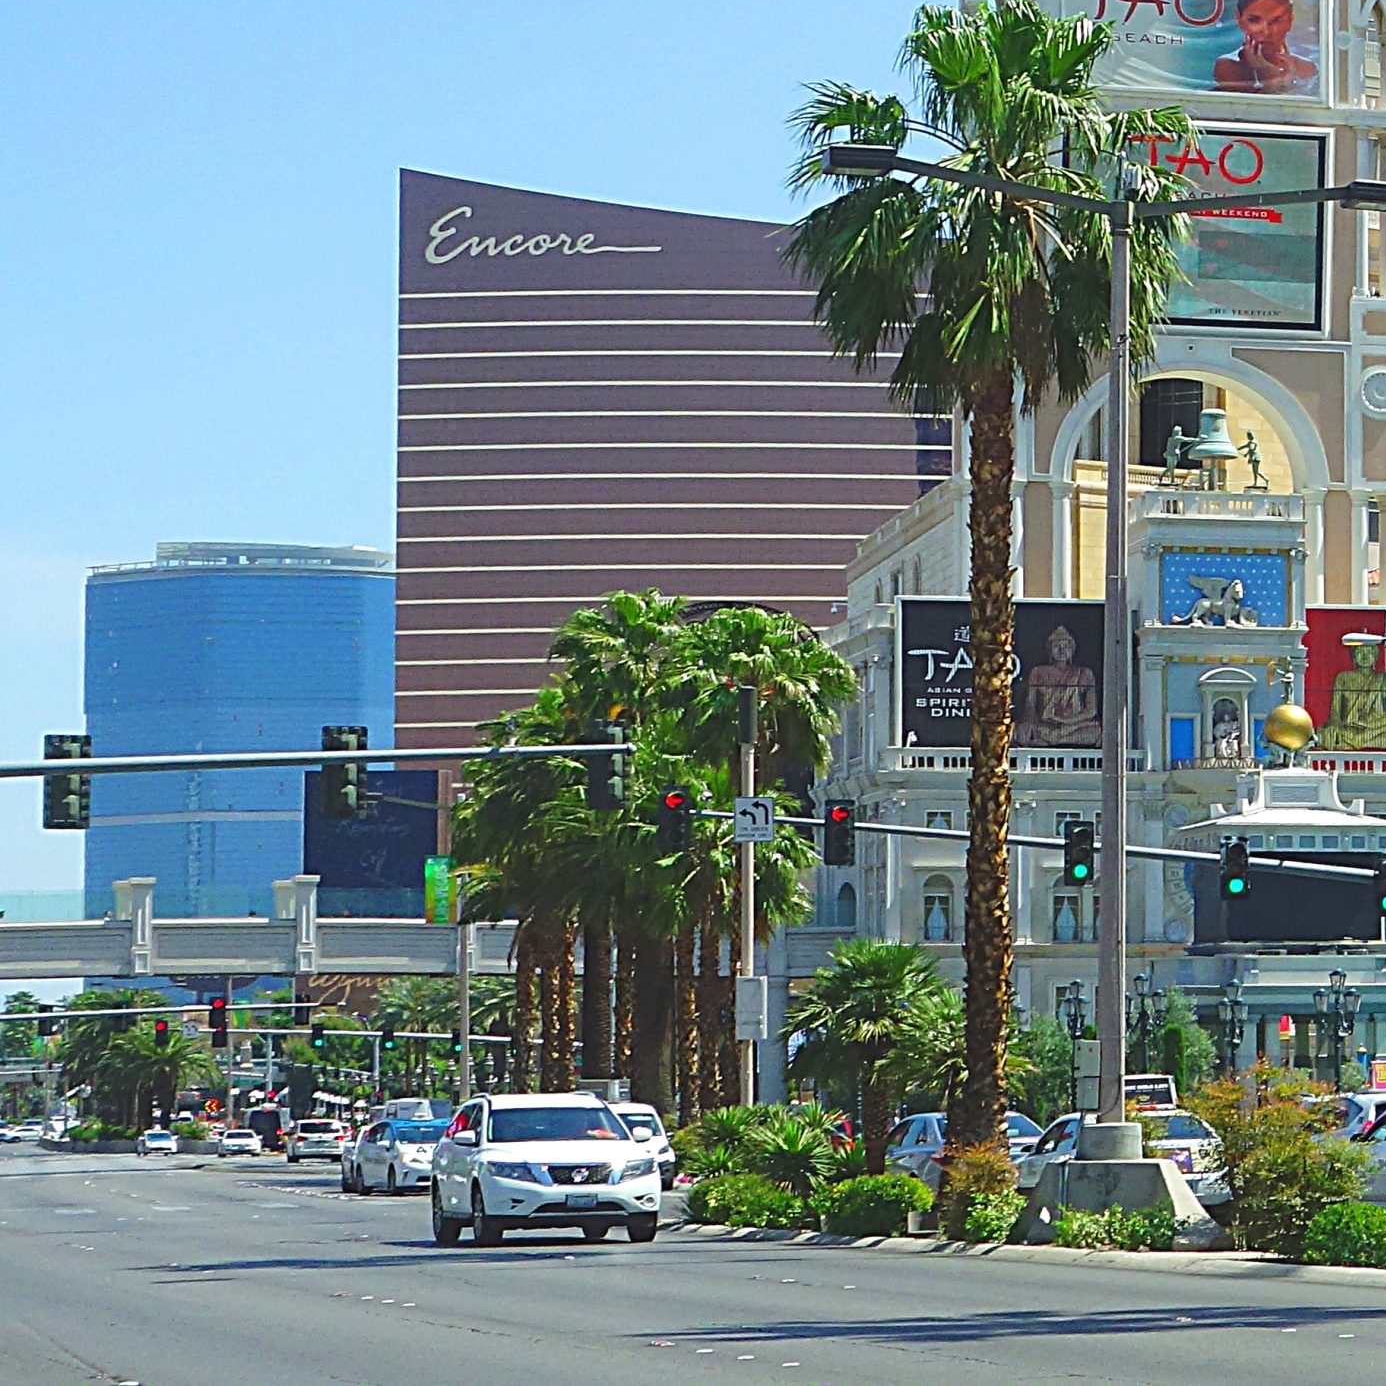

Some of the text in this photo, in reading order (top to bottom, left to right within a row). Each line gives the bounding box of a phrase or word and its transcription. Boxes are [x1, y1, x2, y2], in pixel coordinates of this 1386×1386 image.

[1126, 134, 1264, 185] TAO
[424, 205, 662, 264] Encore
[1213, 209, 1268, 218] WEEKEND
